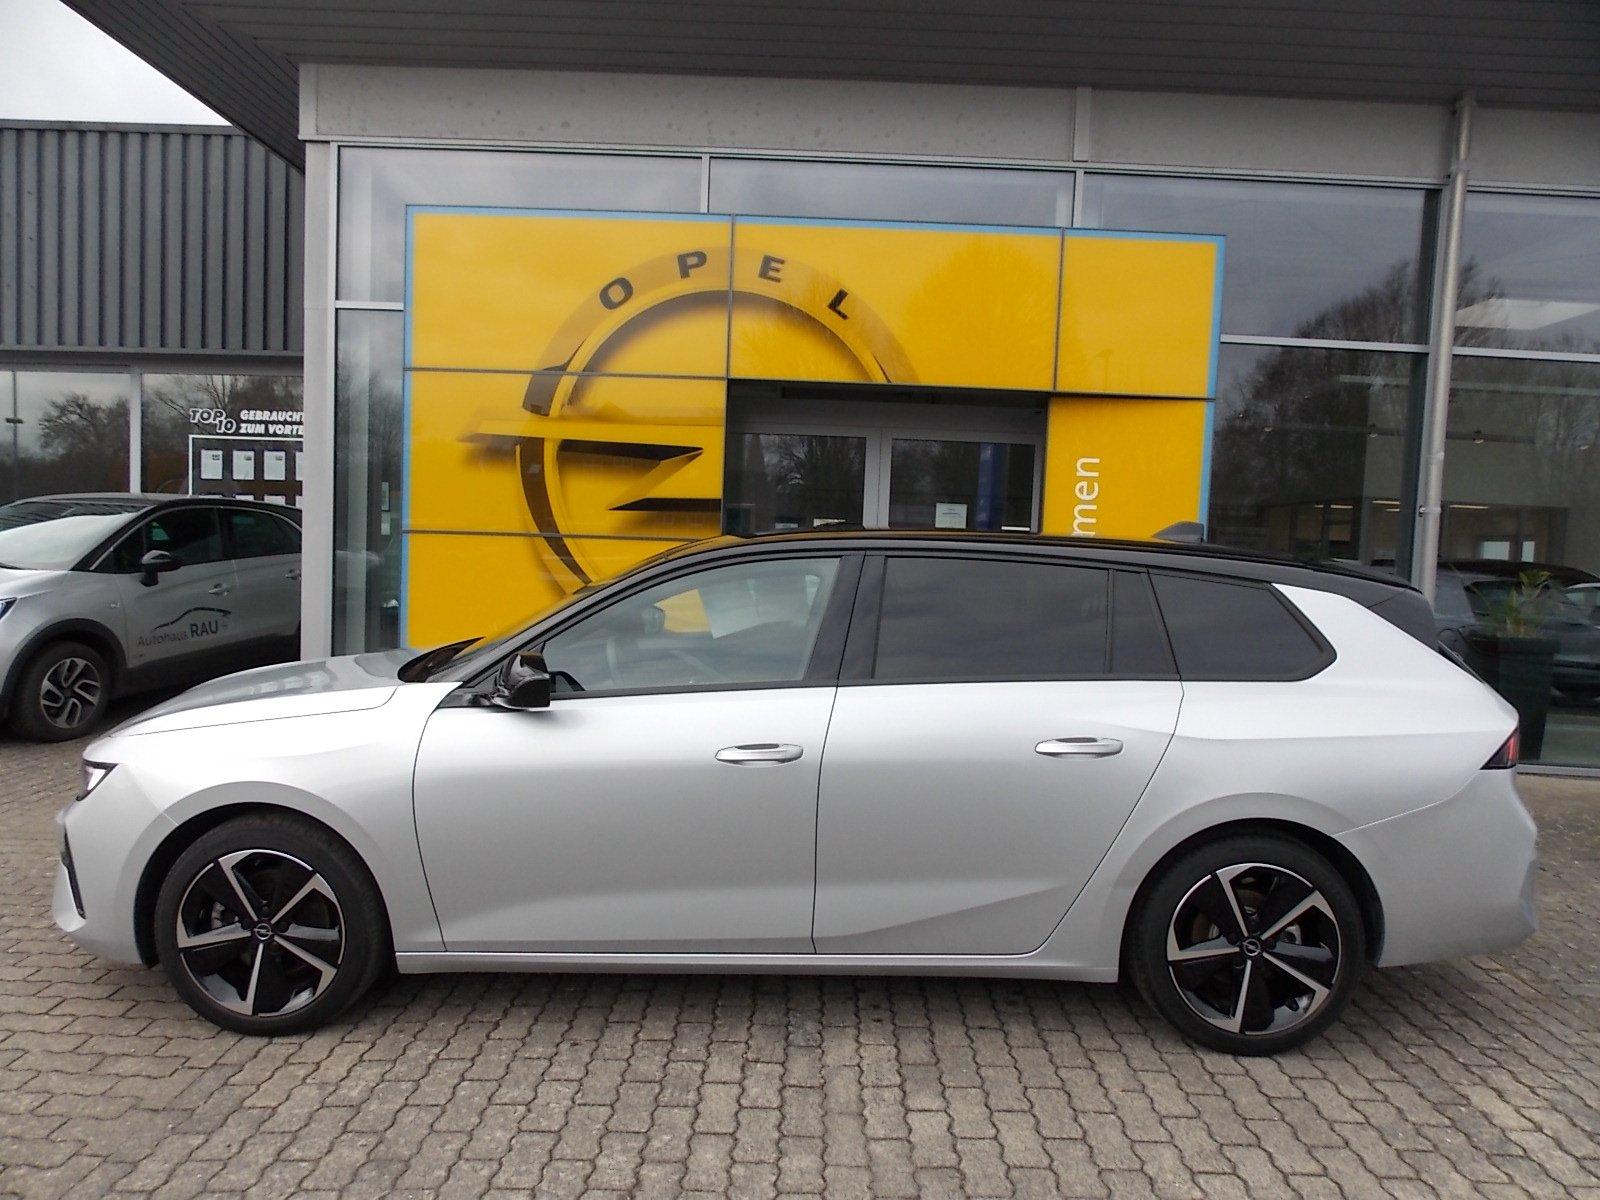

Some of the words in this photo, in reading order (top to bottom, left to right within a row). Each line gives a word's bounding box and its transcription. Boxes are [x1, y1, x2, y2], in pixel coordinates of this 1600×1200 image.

[599, 250, 850, 320] OPEL
[190, 408, 227, 423] TOP
[216, 418, 237, 434] 10
[239, 423, 266, 434] ZUM
[137, 630, 188, 648] Autohaus
[190, 620, 219, 638] RAU
